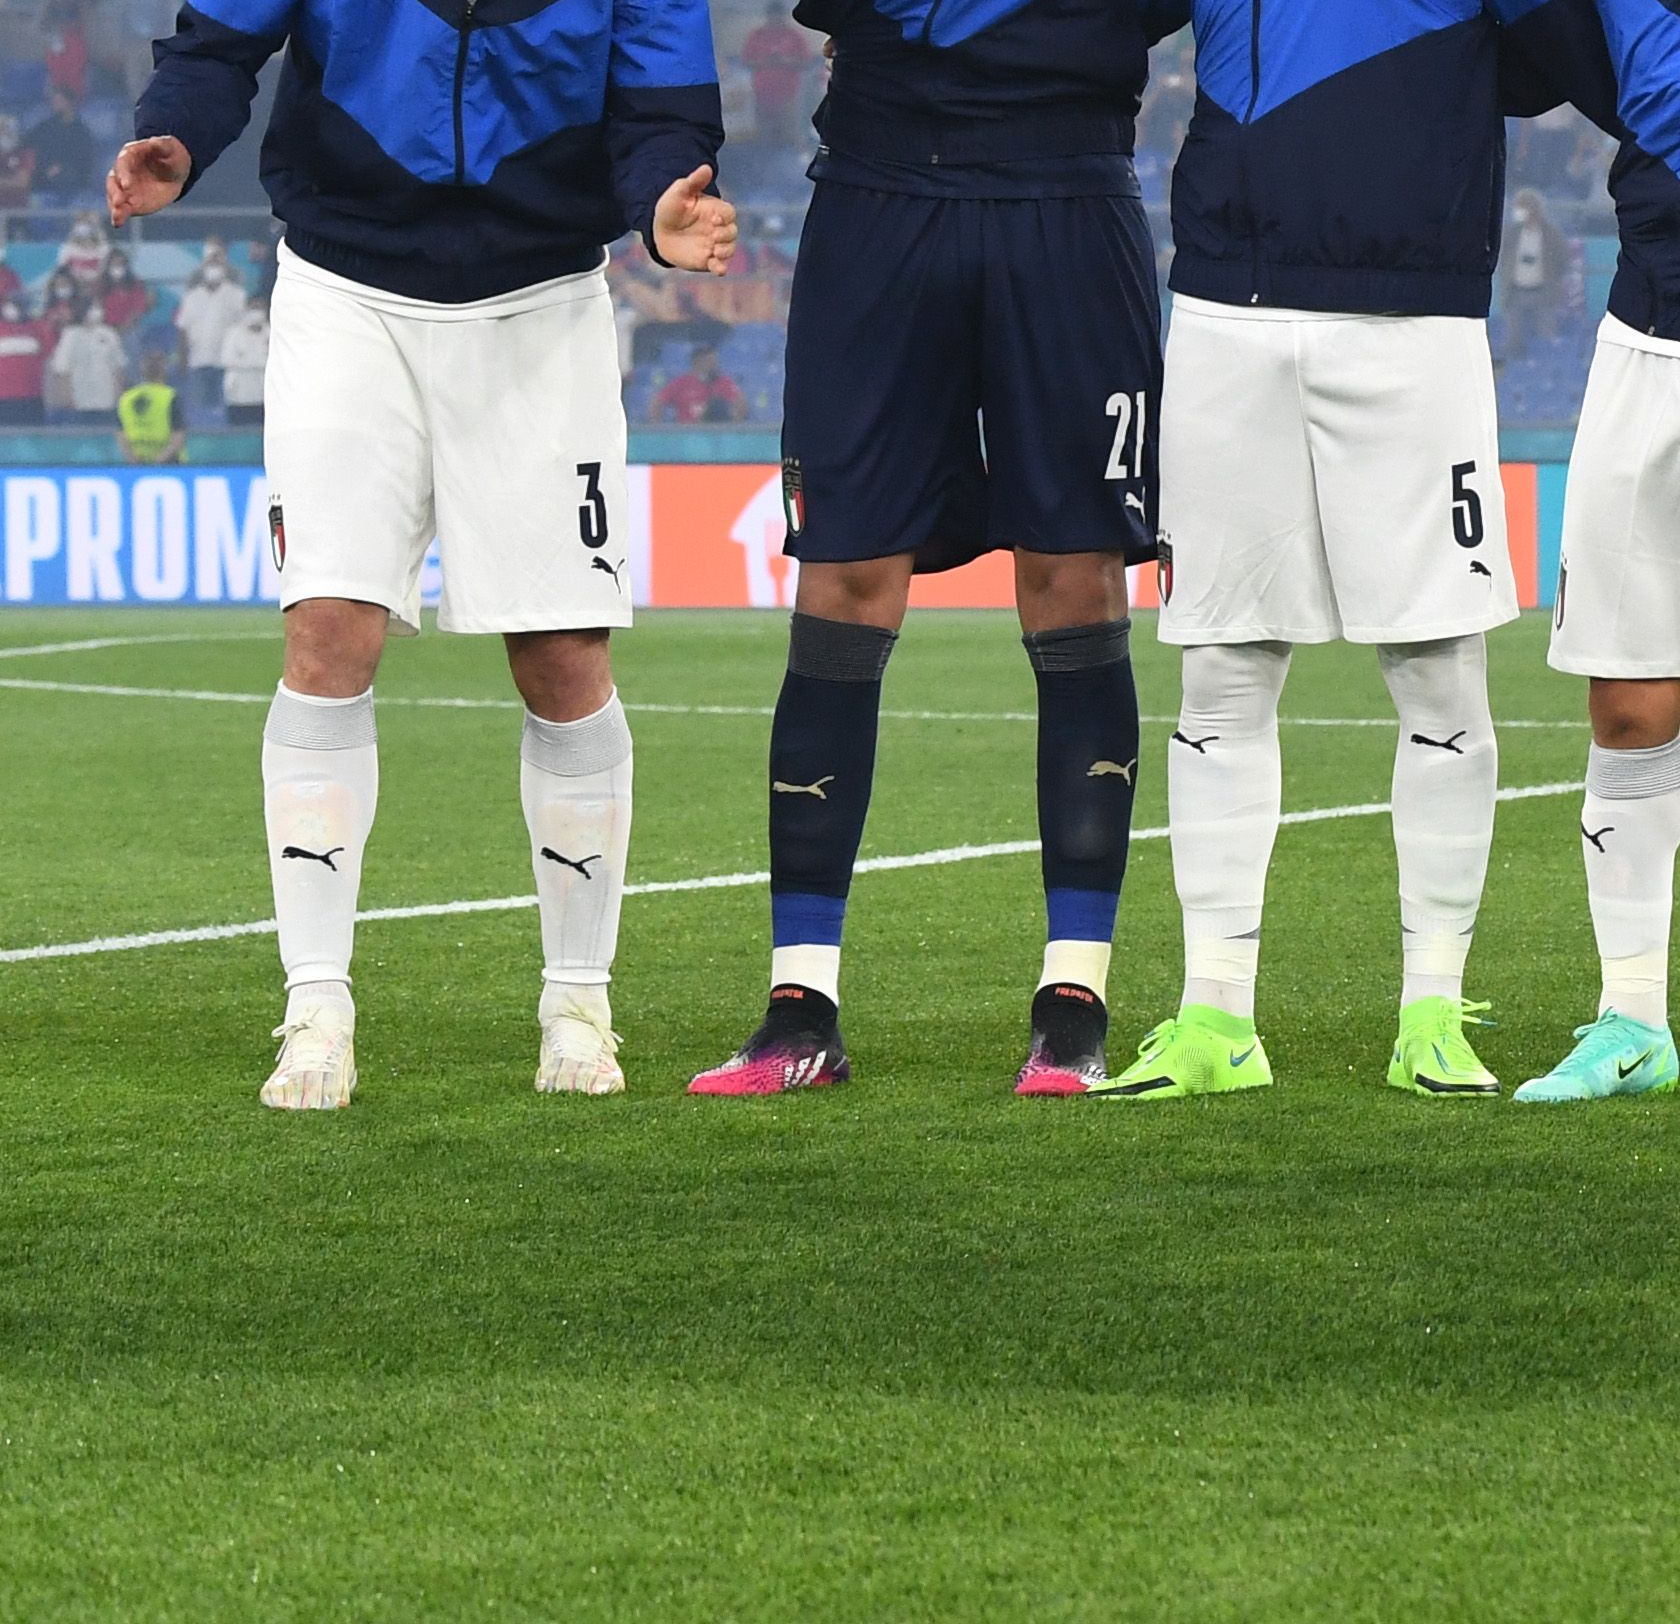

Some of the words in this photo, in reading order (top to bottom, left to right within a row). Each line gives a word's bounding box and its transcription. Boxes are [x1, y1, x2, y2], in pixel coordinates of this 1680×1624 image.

[1104, 390, 1146, 481] 21
[0, 476, 281, 601] PROM
[576, 461, 609, 549] 3
[1451, 459, 1484, 549] 5
